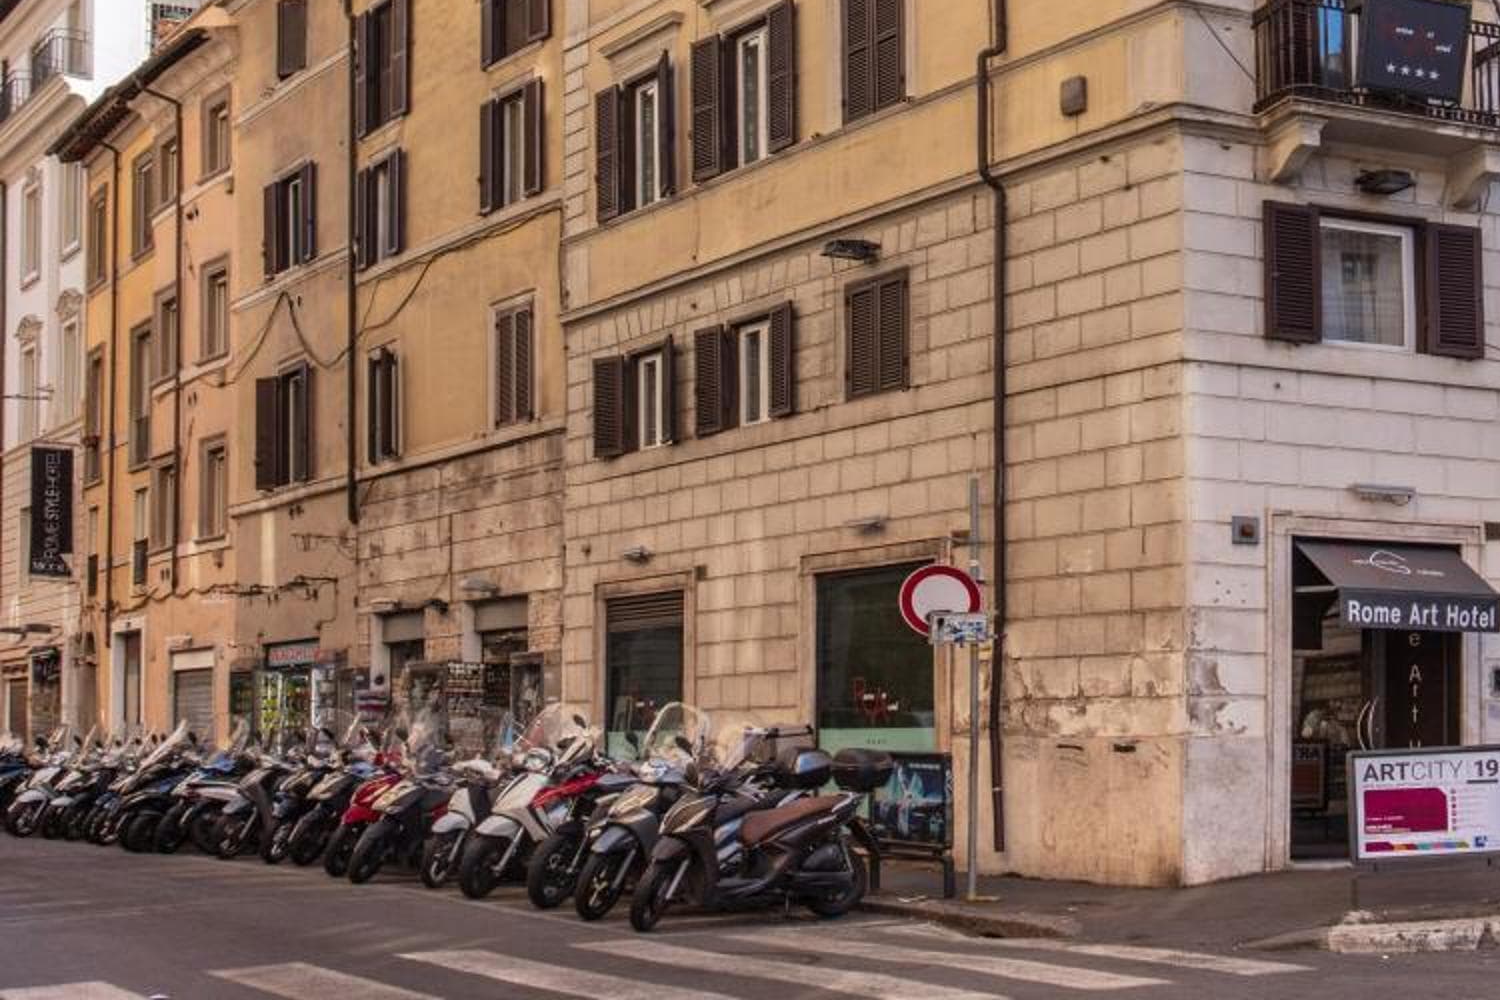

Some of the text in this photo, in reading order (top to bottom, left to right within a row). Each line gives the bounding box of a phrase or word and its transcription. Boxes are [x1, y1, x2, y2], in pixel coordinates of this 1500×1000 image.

[1348, 600, 1496, 628] Rome Art Hotel
[1363, 759, 1499, 782] ARTCITY 19
